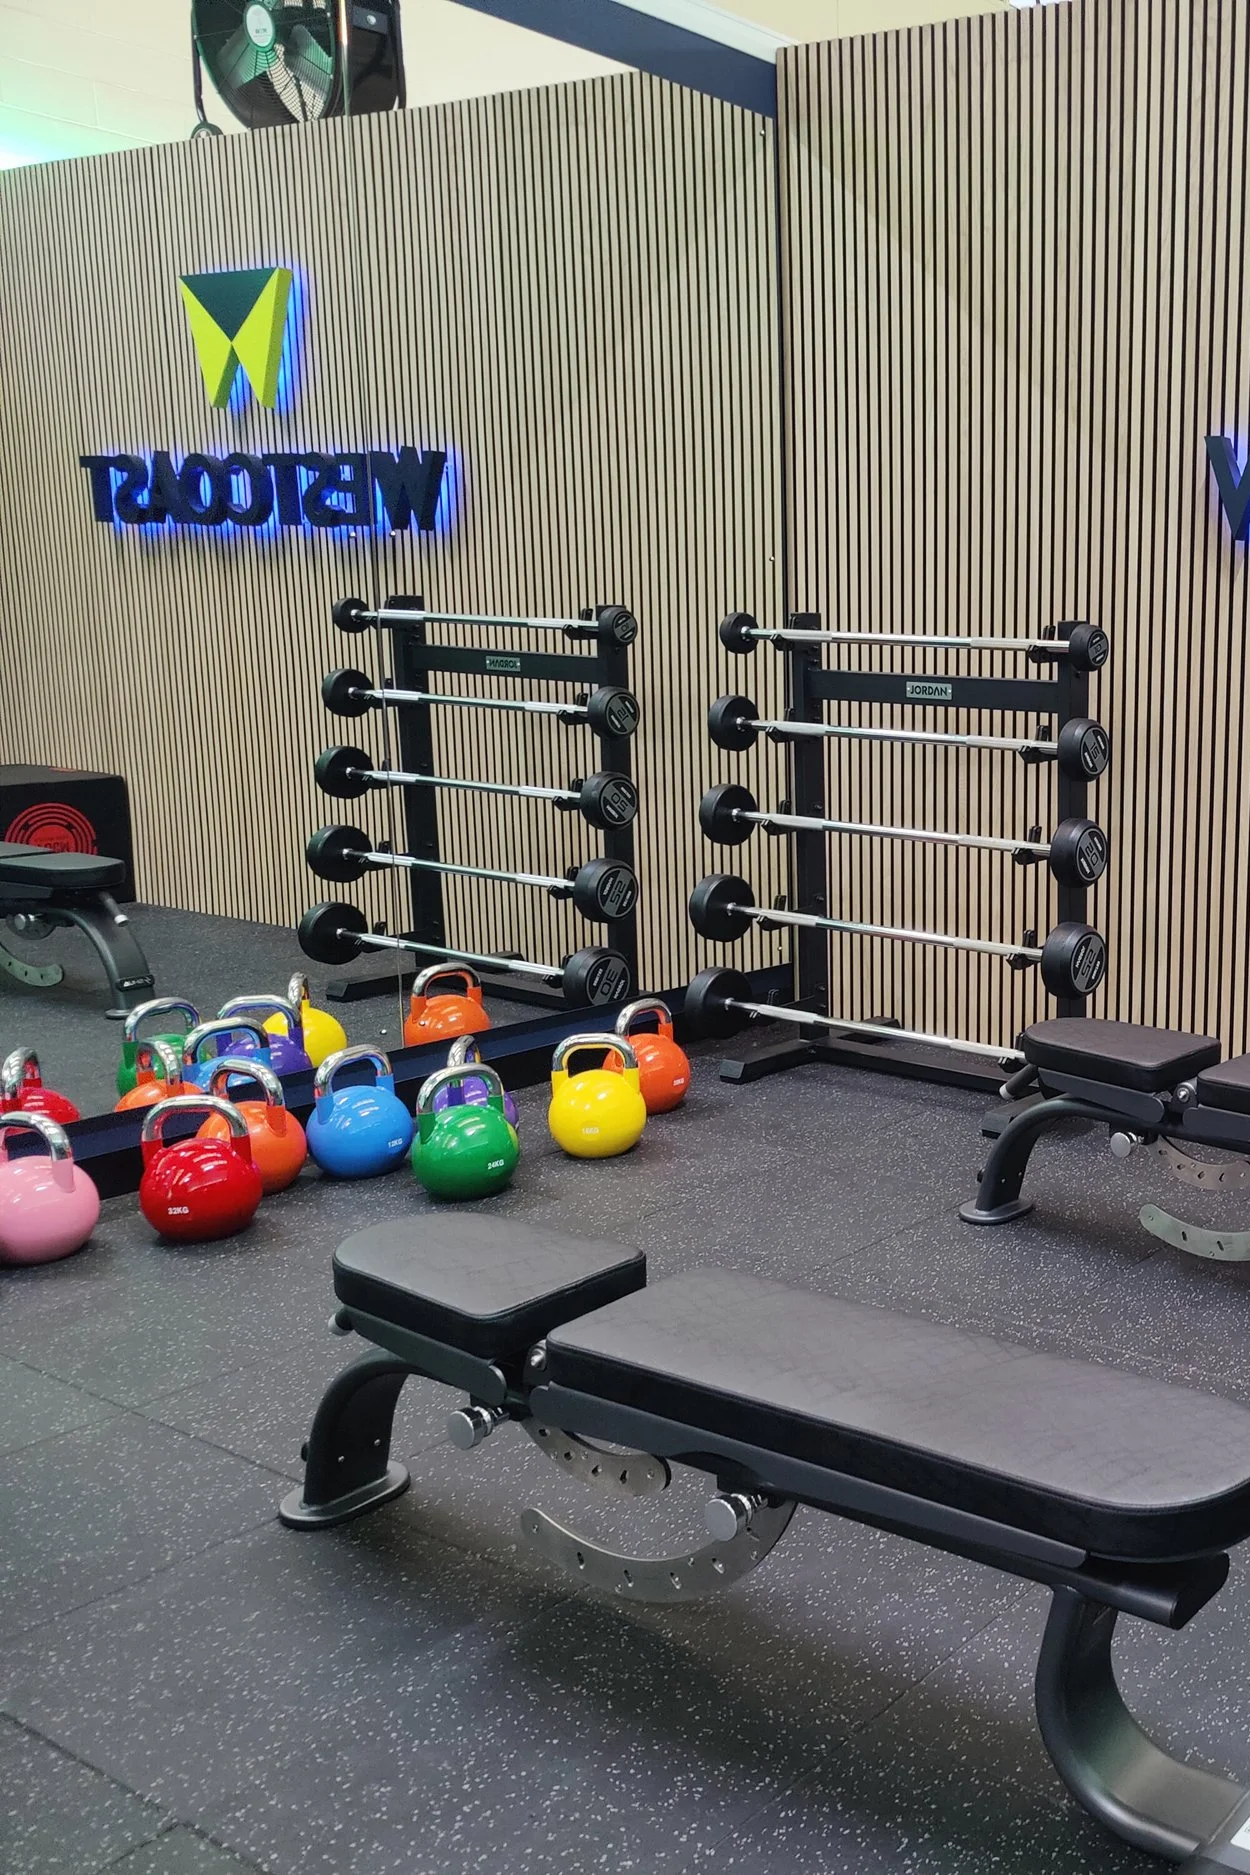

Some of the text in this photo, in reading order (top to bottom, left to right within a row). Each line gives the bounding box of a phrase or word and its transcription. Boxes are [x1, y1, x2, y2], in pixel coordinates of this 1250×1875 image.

[910, 685, 948, 697] JORDAN
[1084, 842, 1099, 867] 20
[167, 1206, 190, 1216] 32KG
